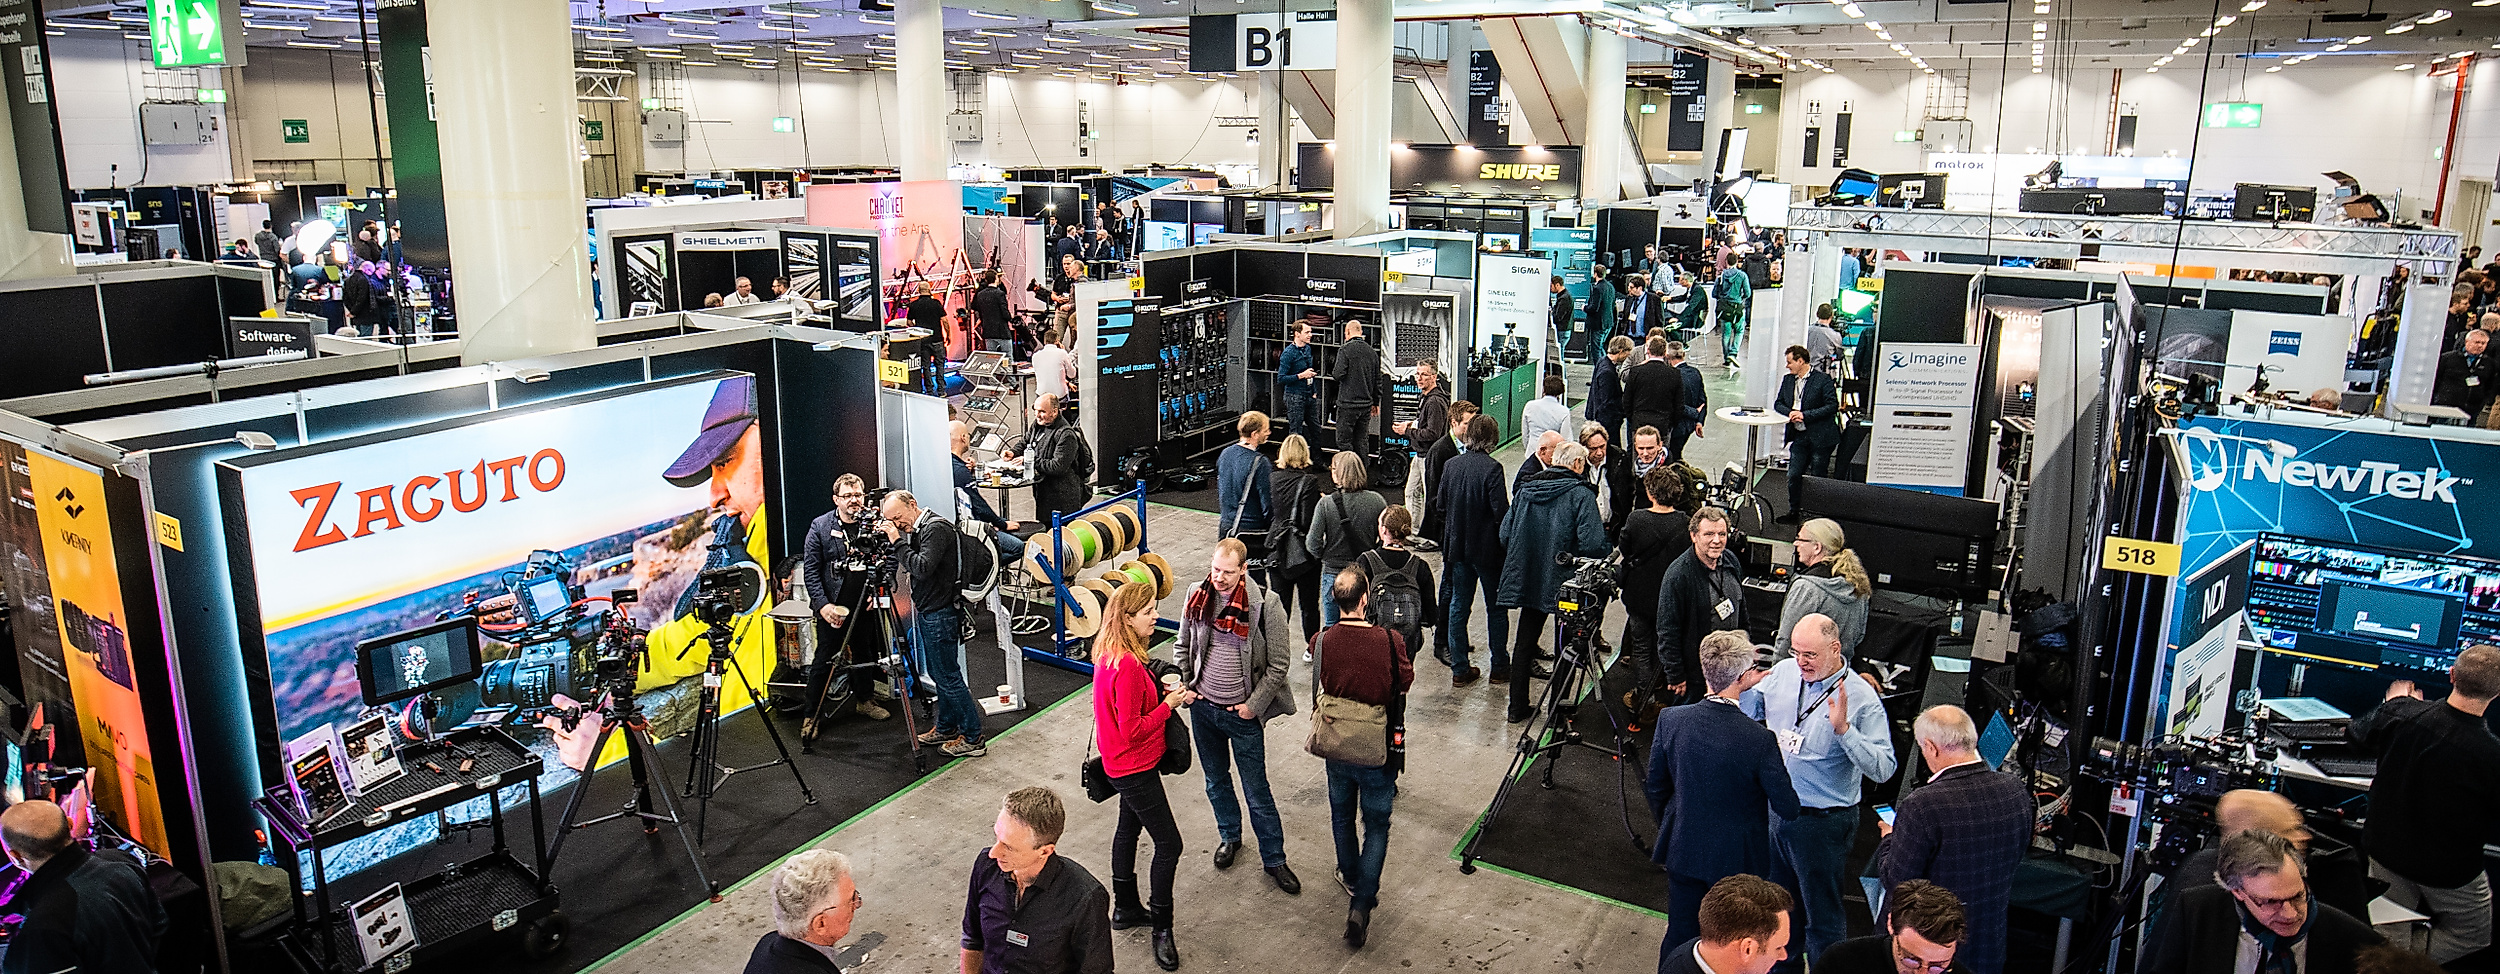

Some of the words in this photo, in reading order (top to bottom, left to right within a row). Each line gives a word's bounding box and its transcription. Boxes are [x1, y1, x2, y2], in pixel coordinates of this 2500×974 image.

[1246, 28, 1291, 67] B1
[1470, 72, 1482, 81] B2
[1673, 70, 1686, 79] B2
[1935, 160, 1984, 169] matrox
[1480, 163, 1560, 182] SHURE
[869, 196, 904, 215] CHAUVET
[911, 223, 930, 235] Arts
[682, 236, 766, 246] GHIELMETTI
[1511, 266, 1541, 275] SIGMA
[1314, 281, 1337, 290] KLOTZ
[238, 329, 297, 343] Software-
[2270, 336, 2300, 346] ZEISS
[266, 346, 308, 358] defid
[1909, 351, 1967, 367] Imagine
[888, 365, 903, 378] 521
[1102, 365, 1112, 375] the
[1113, 363, 1132, 375] signal
[1132, 362, 1156, 372] masters
[1910, 379, 1936, 387] Network
[2243, 448, 2461, 504] NewTek
[289, 448, 566, 553] ZACUTO
[162, 521, 178, 541] 523
[2116, 546, 2157, 567] 518
